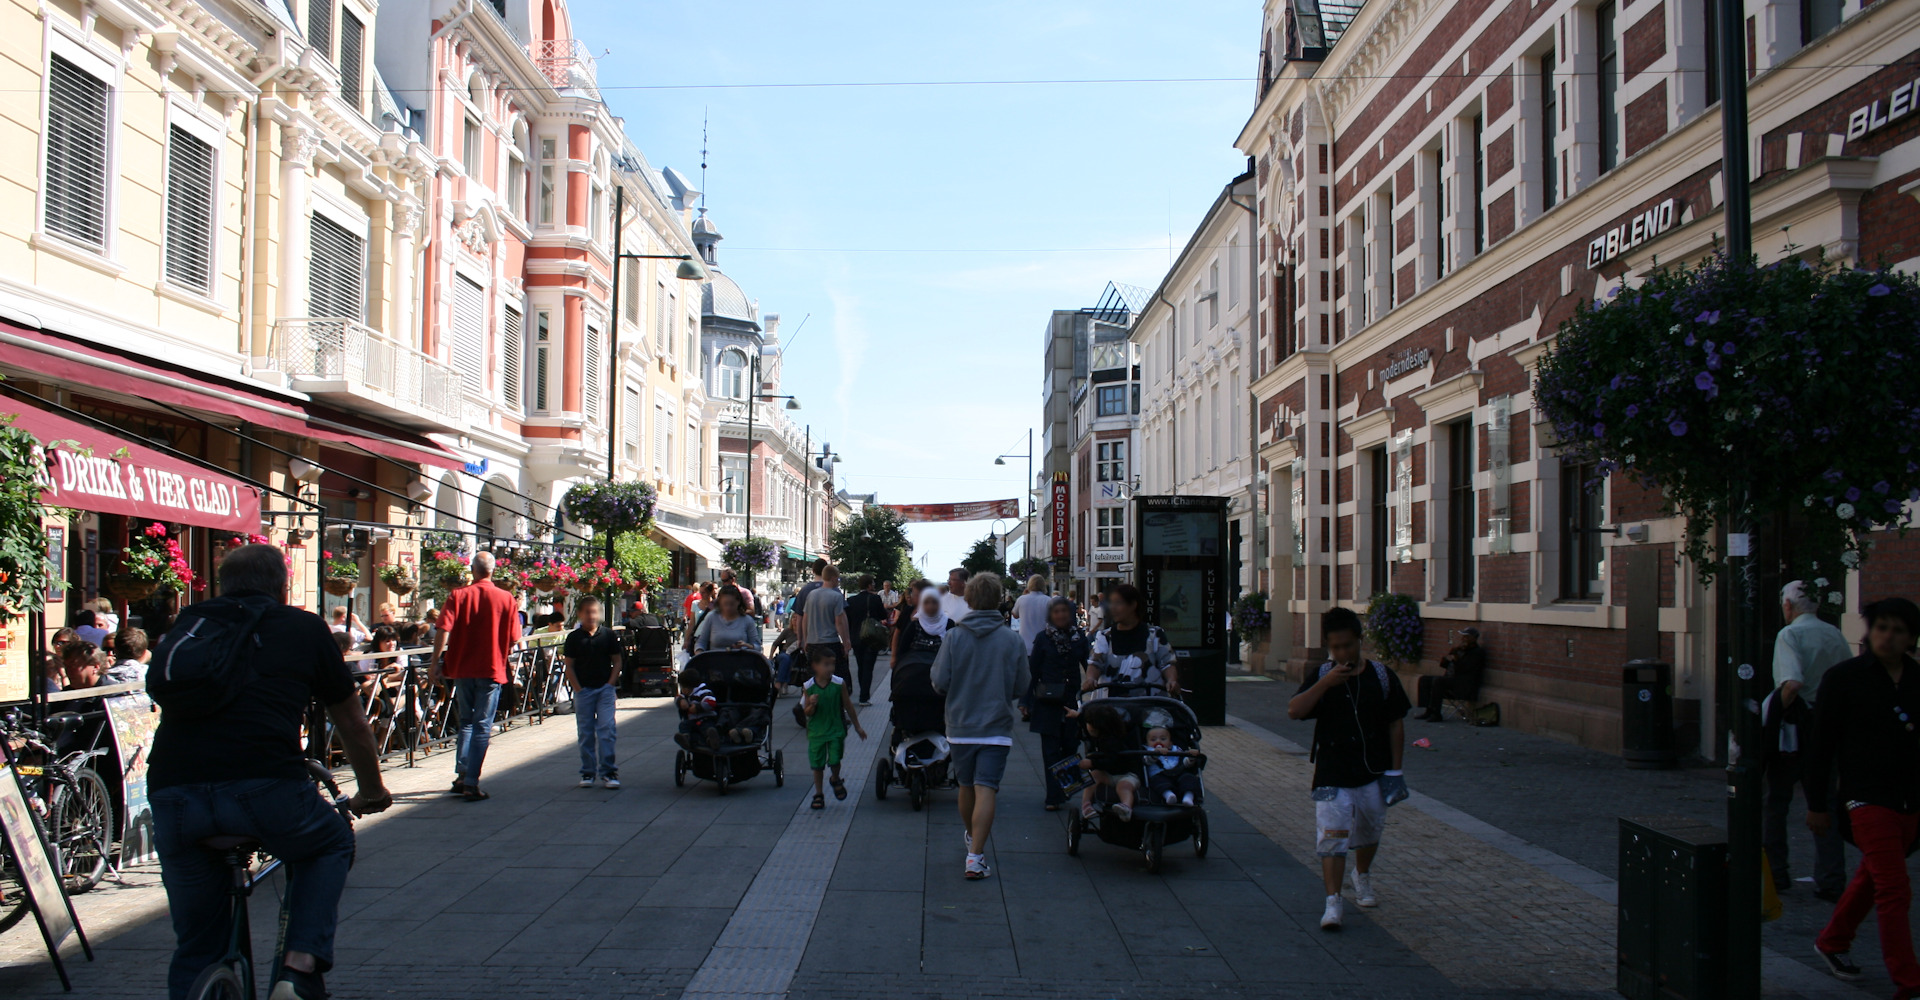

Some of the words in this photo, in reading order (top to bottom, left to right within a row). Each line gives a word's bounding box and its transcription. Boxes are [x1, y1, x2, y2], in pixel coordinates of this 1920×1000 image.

[1605, 197, 1674, 261] BLEND
[1379, 347, 1429, 383] moderndesign
[58, 450, 127, 500] DRIKK
[128, 463, 145, 502] &
[143, 467, 190, 510] VÆR
[190, 477, 231, 516] GLAD
[1055, 486, 1066, 556] McDonald's
[1207, 569, 1215, 645] KULTURINFO
